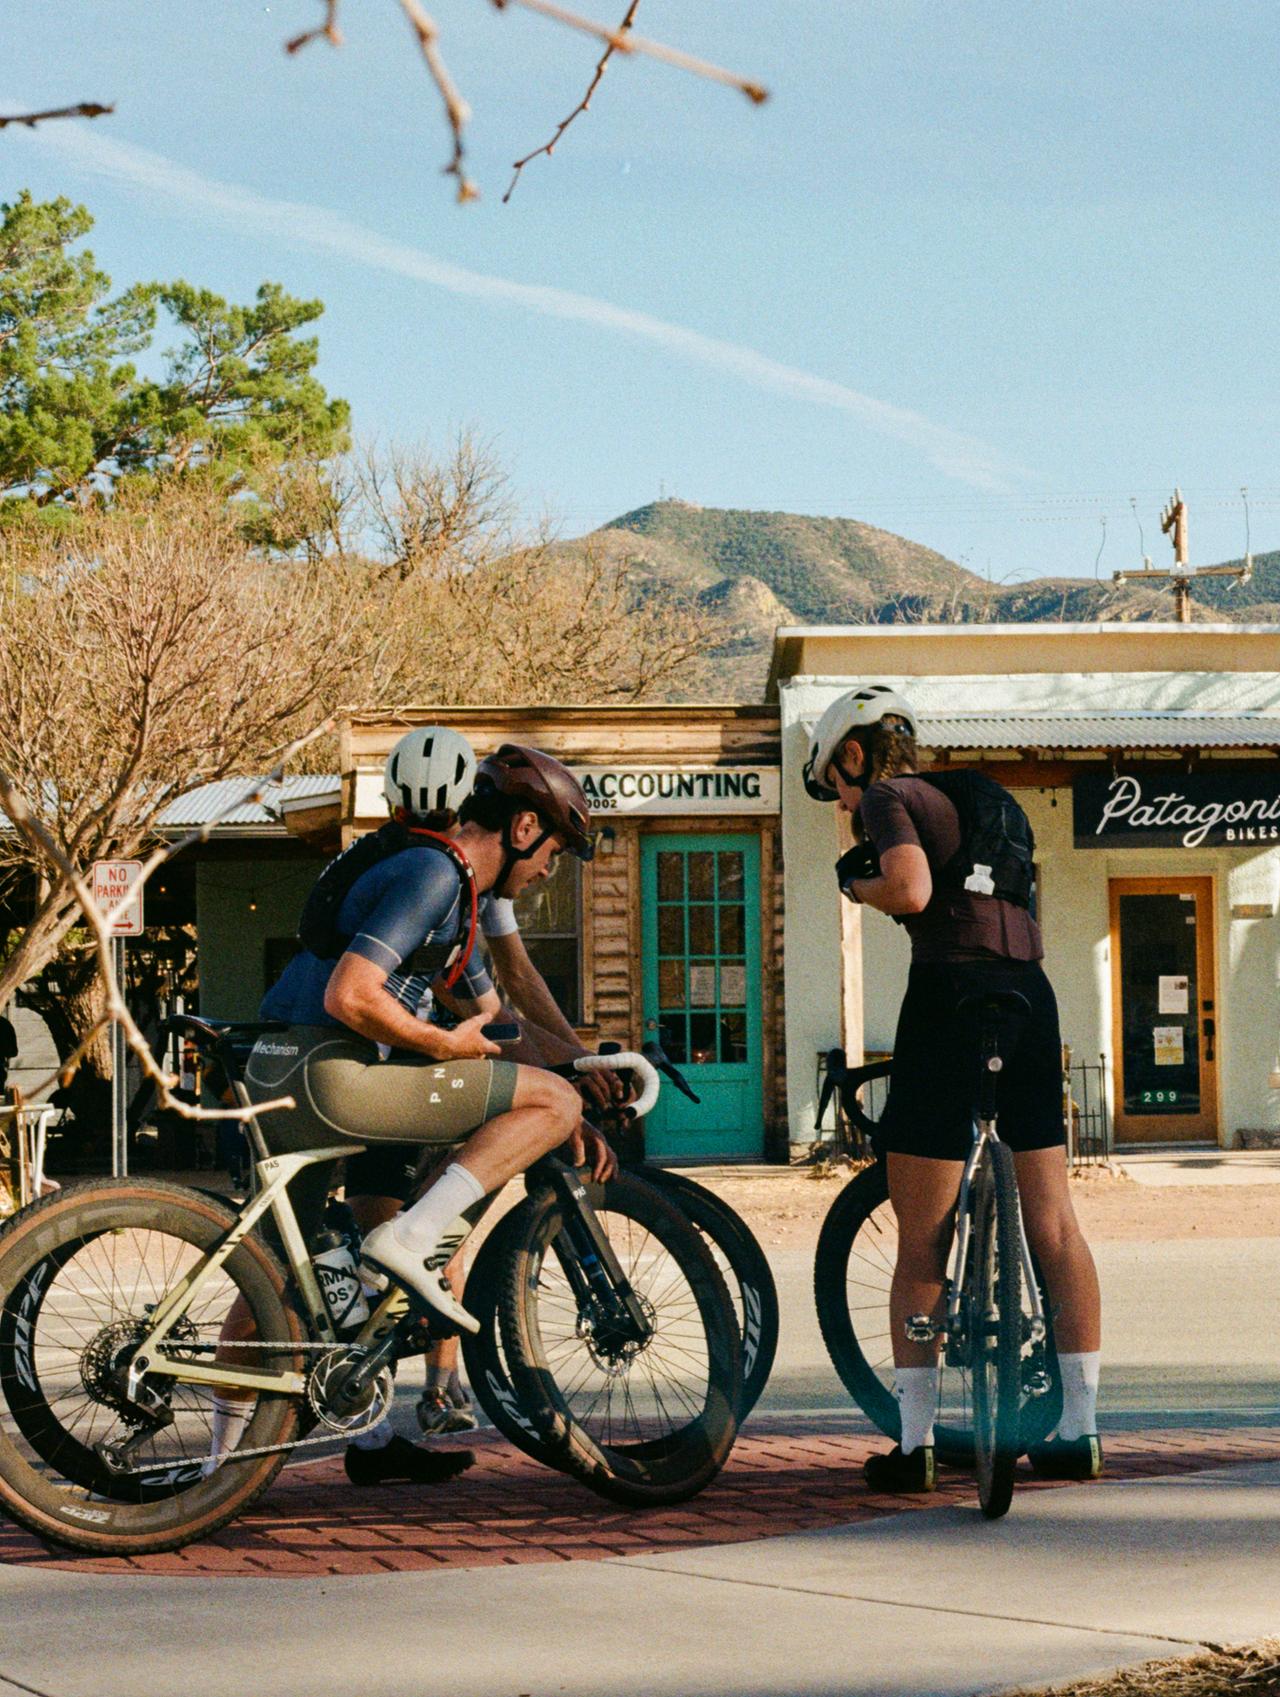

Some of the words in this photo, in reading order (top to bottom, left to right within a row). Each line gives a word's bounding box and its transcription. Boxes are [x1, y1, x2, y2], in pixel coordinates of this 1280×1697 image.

[582, 773, 761, 798] ACCOUNTING
[1226, 825, 1278, 841] BIKES
[108, 868, 128, 881] NO
[1143, 1091, 1177, 1102] 299
[264, 1160, 280, 1171] PAS
[572, 1186, 587, 1200] PAS
